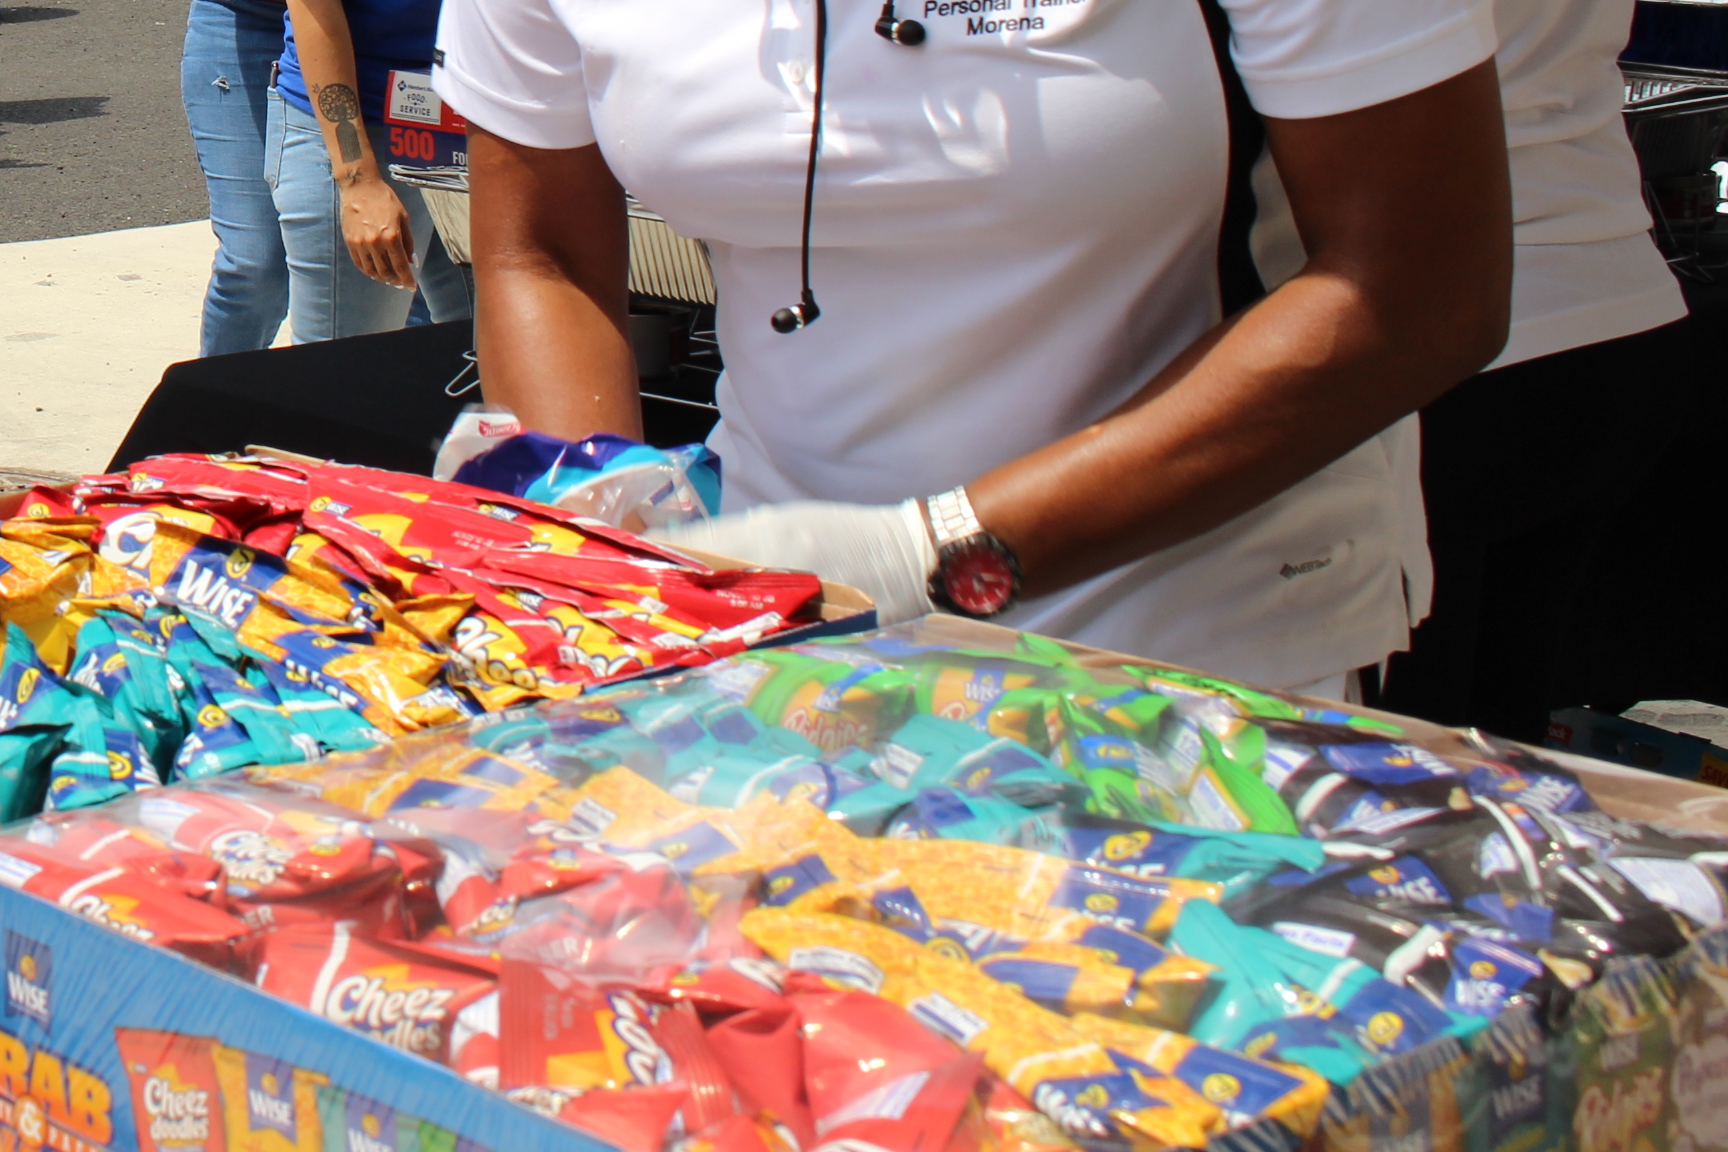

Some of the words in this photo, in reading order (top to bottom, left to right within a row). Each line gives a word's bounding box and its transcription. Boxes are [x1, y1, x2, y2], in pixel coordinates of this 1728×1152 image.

[966, 15, 1045, 36] Morena
[399, 104, 431, 117] SERVICE
[407, 92, 426, 104] FOOD
[389, 127, 436, 161] 500
[176, 558, 254, 627] WISE
[6, 970, 49, 1017] WISE
[325, 974, 458, 1027] Cheez
[142, 1075, 210, 1119] Cheez
[248, 1087, 295, 1128] WISE
[18, 1099, 44, 1145] &
[149, 1112, 211, 1142] doodles
